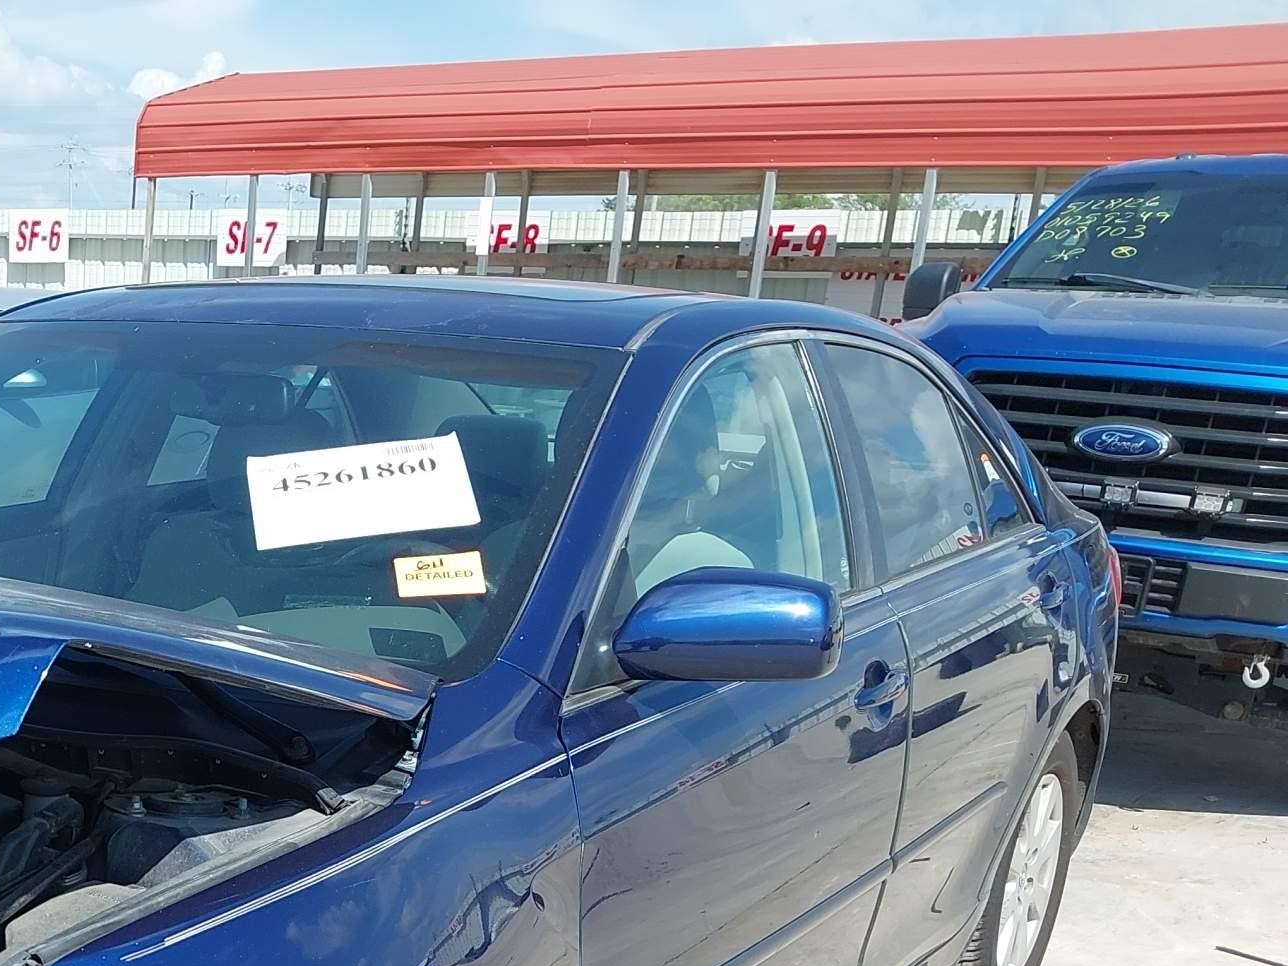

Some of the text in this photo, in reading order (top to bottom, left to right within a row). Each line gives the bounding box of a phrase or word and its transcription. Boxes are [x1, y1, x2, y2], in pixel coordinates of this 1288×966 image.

[1060, 195, 1161, 215] 5/28/26
[16, 220, 62, 252] SF-6
[490, 223, 540, 254] F-8
[766, 224, 827, 257] F-9
[1094, 431, 1147, 454] Ford
[272, 457, 437, 492] 45261860
[405, 569, 474, 581] DETAILED
